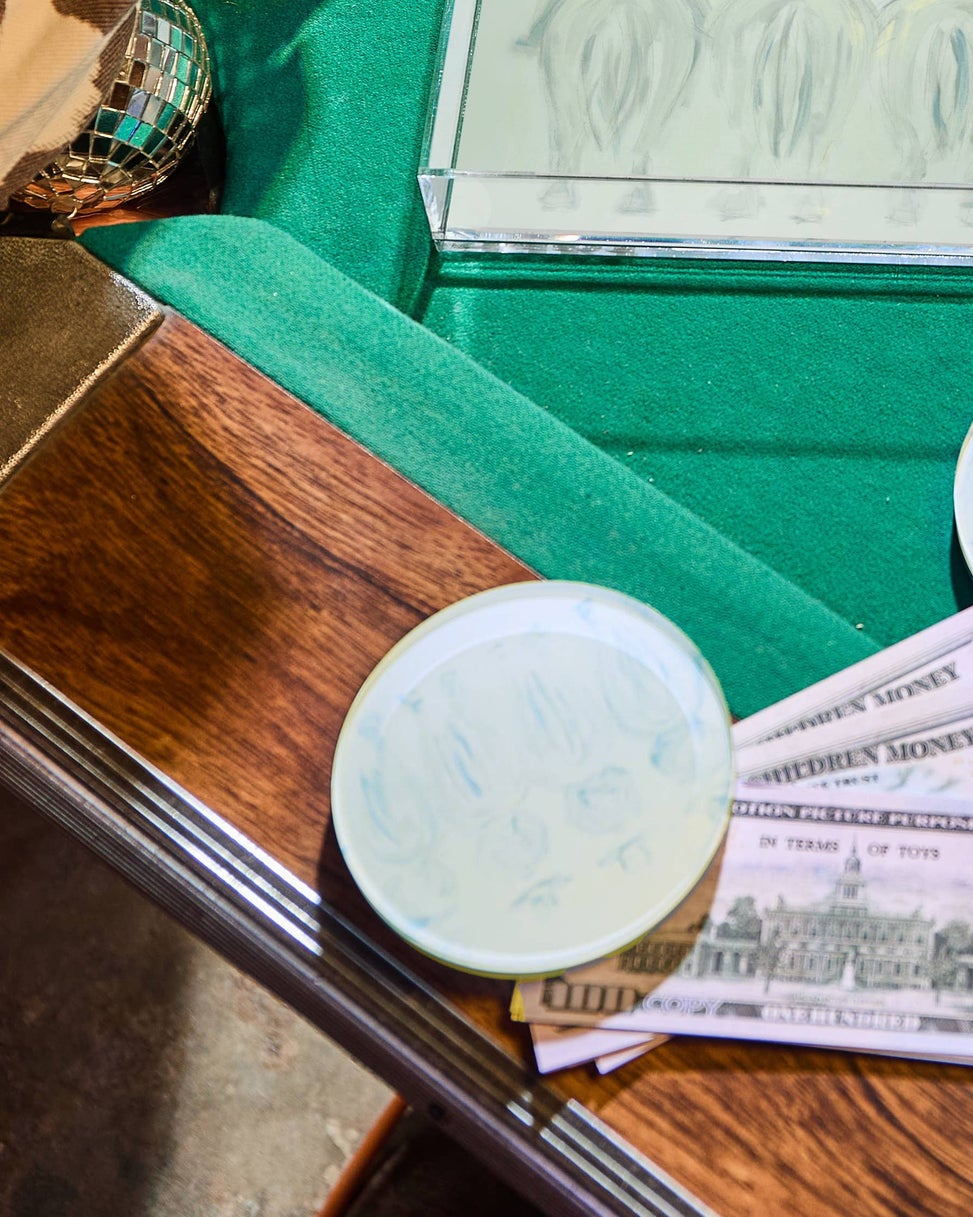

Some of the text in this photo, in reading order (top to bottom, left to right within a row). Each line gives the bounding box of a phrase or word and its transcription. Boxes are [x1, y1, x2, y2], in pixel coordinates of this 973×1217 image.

[873, 661, 961, 707] MONEY
[731, 800, 797, 819] OTION
[799, 806, 885, 825] PICTURE
[759, 836, 941, 861] IN TERMS OF TOYS
[642, 994, 721, 1017] COPY
